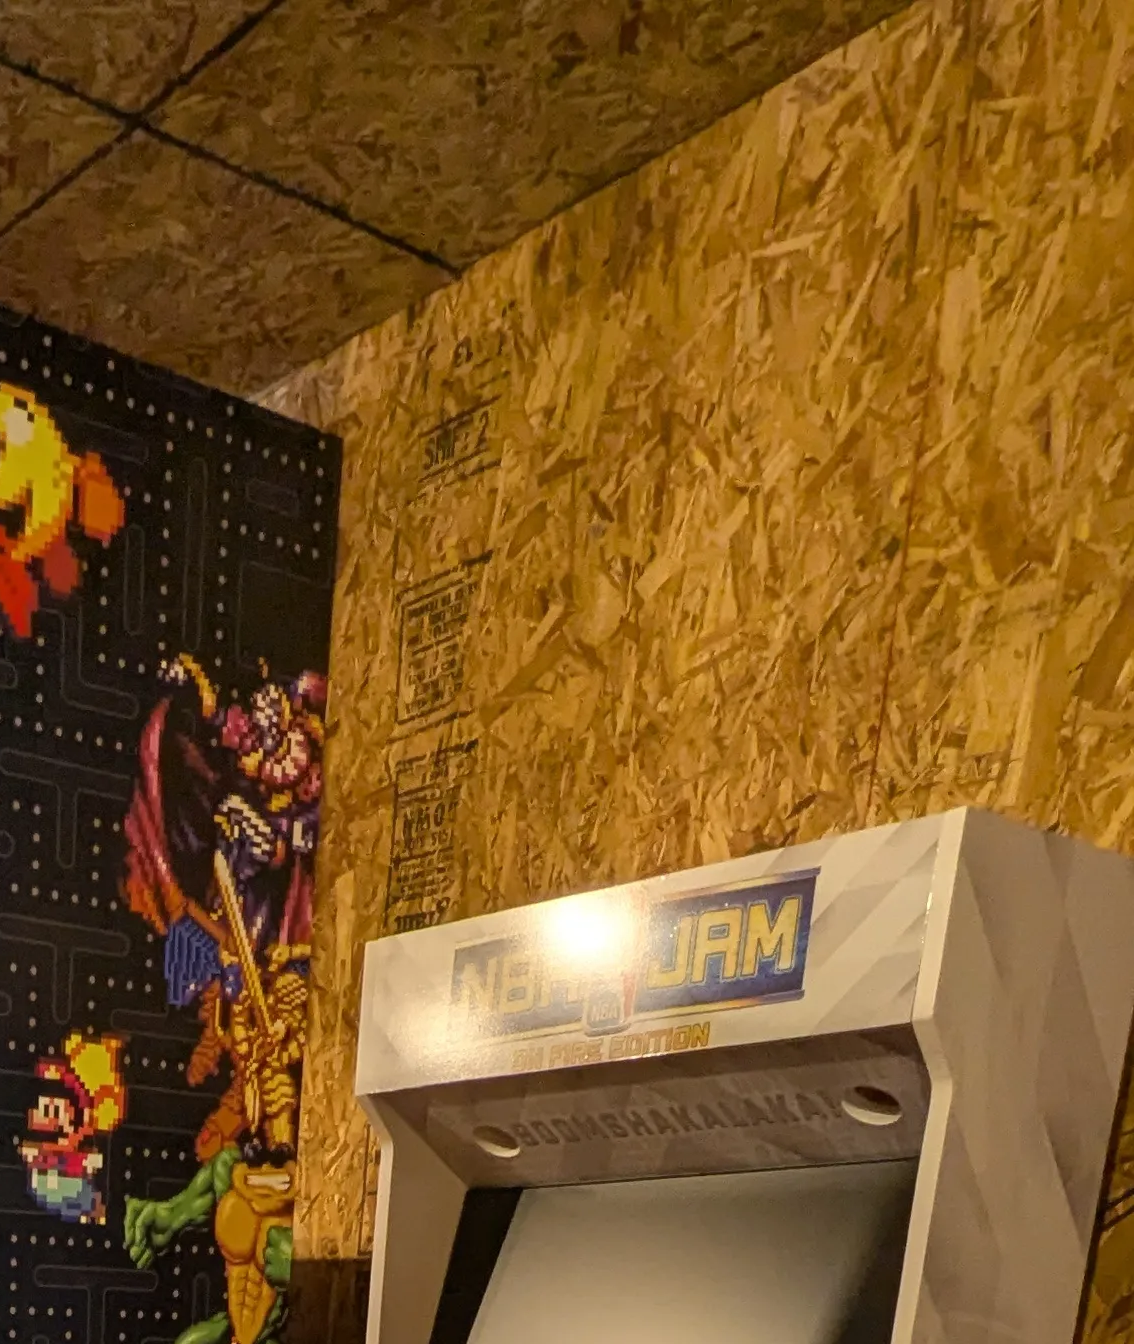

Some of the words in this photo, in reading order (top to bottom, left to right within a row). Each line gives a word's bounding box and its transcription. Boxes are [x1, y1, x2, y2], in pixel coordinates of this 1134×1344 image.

[646, 894, 803, 990] JAM
[548, 1037, 603, 1068] FIRE
[608, 1020, 711, 1060] EDITION
